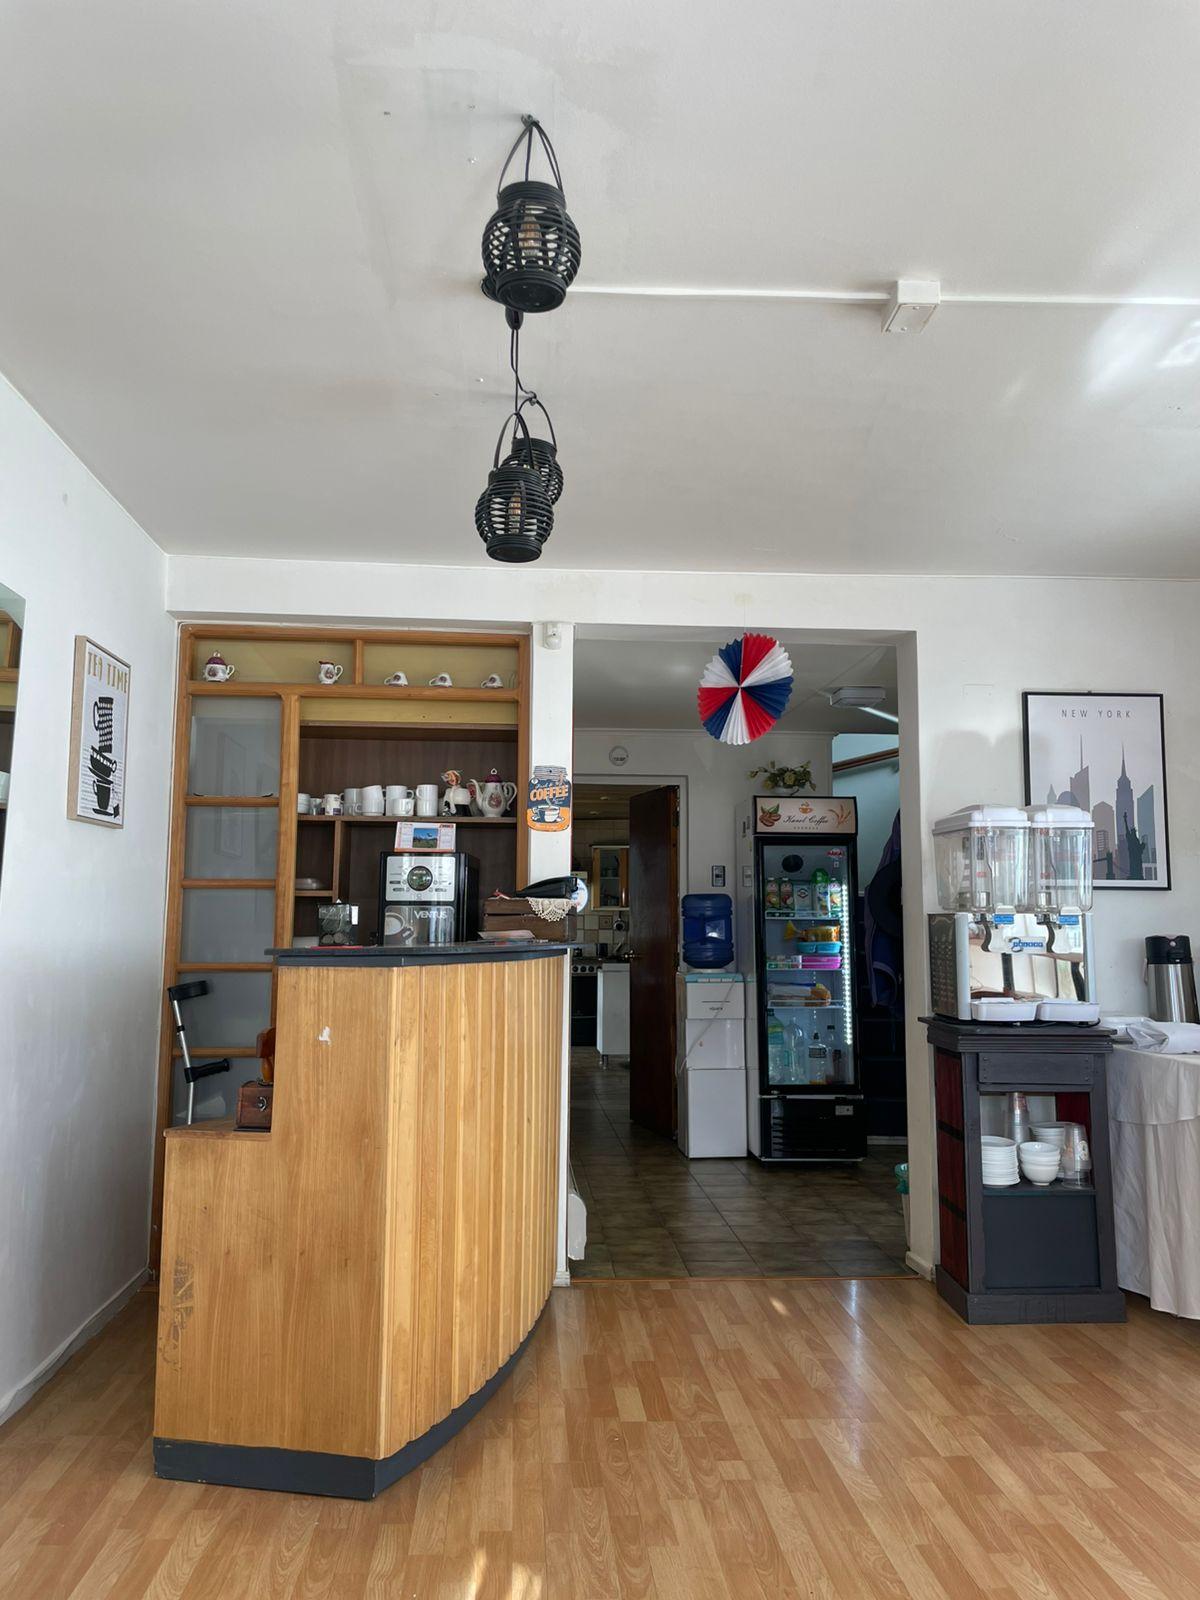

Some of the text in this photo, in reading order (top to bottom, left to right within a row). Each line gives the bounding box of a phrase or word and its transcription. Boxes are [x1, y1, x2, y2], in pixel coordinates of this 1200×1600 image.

[88, 651, 127, 694] TEA TIME
[1061, 709, 1131, 718] NEW YORK
[529, 784, 569, 802] COFFEE
[808, 815, 829, 826] Coffee
[414, 910, 448, 919] VENTUS
